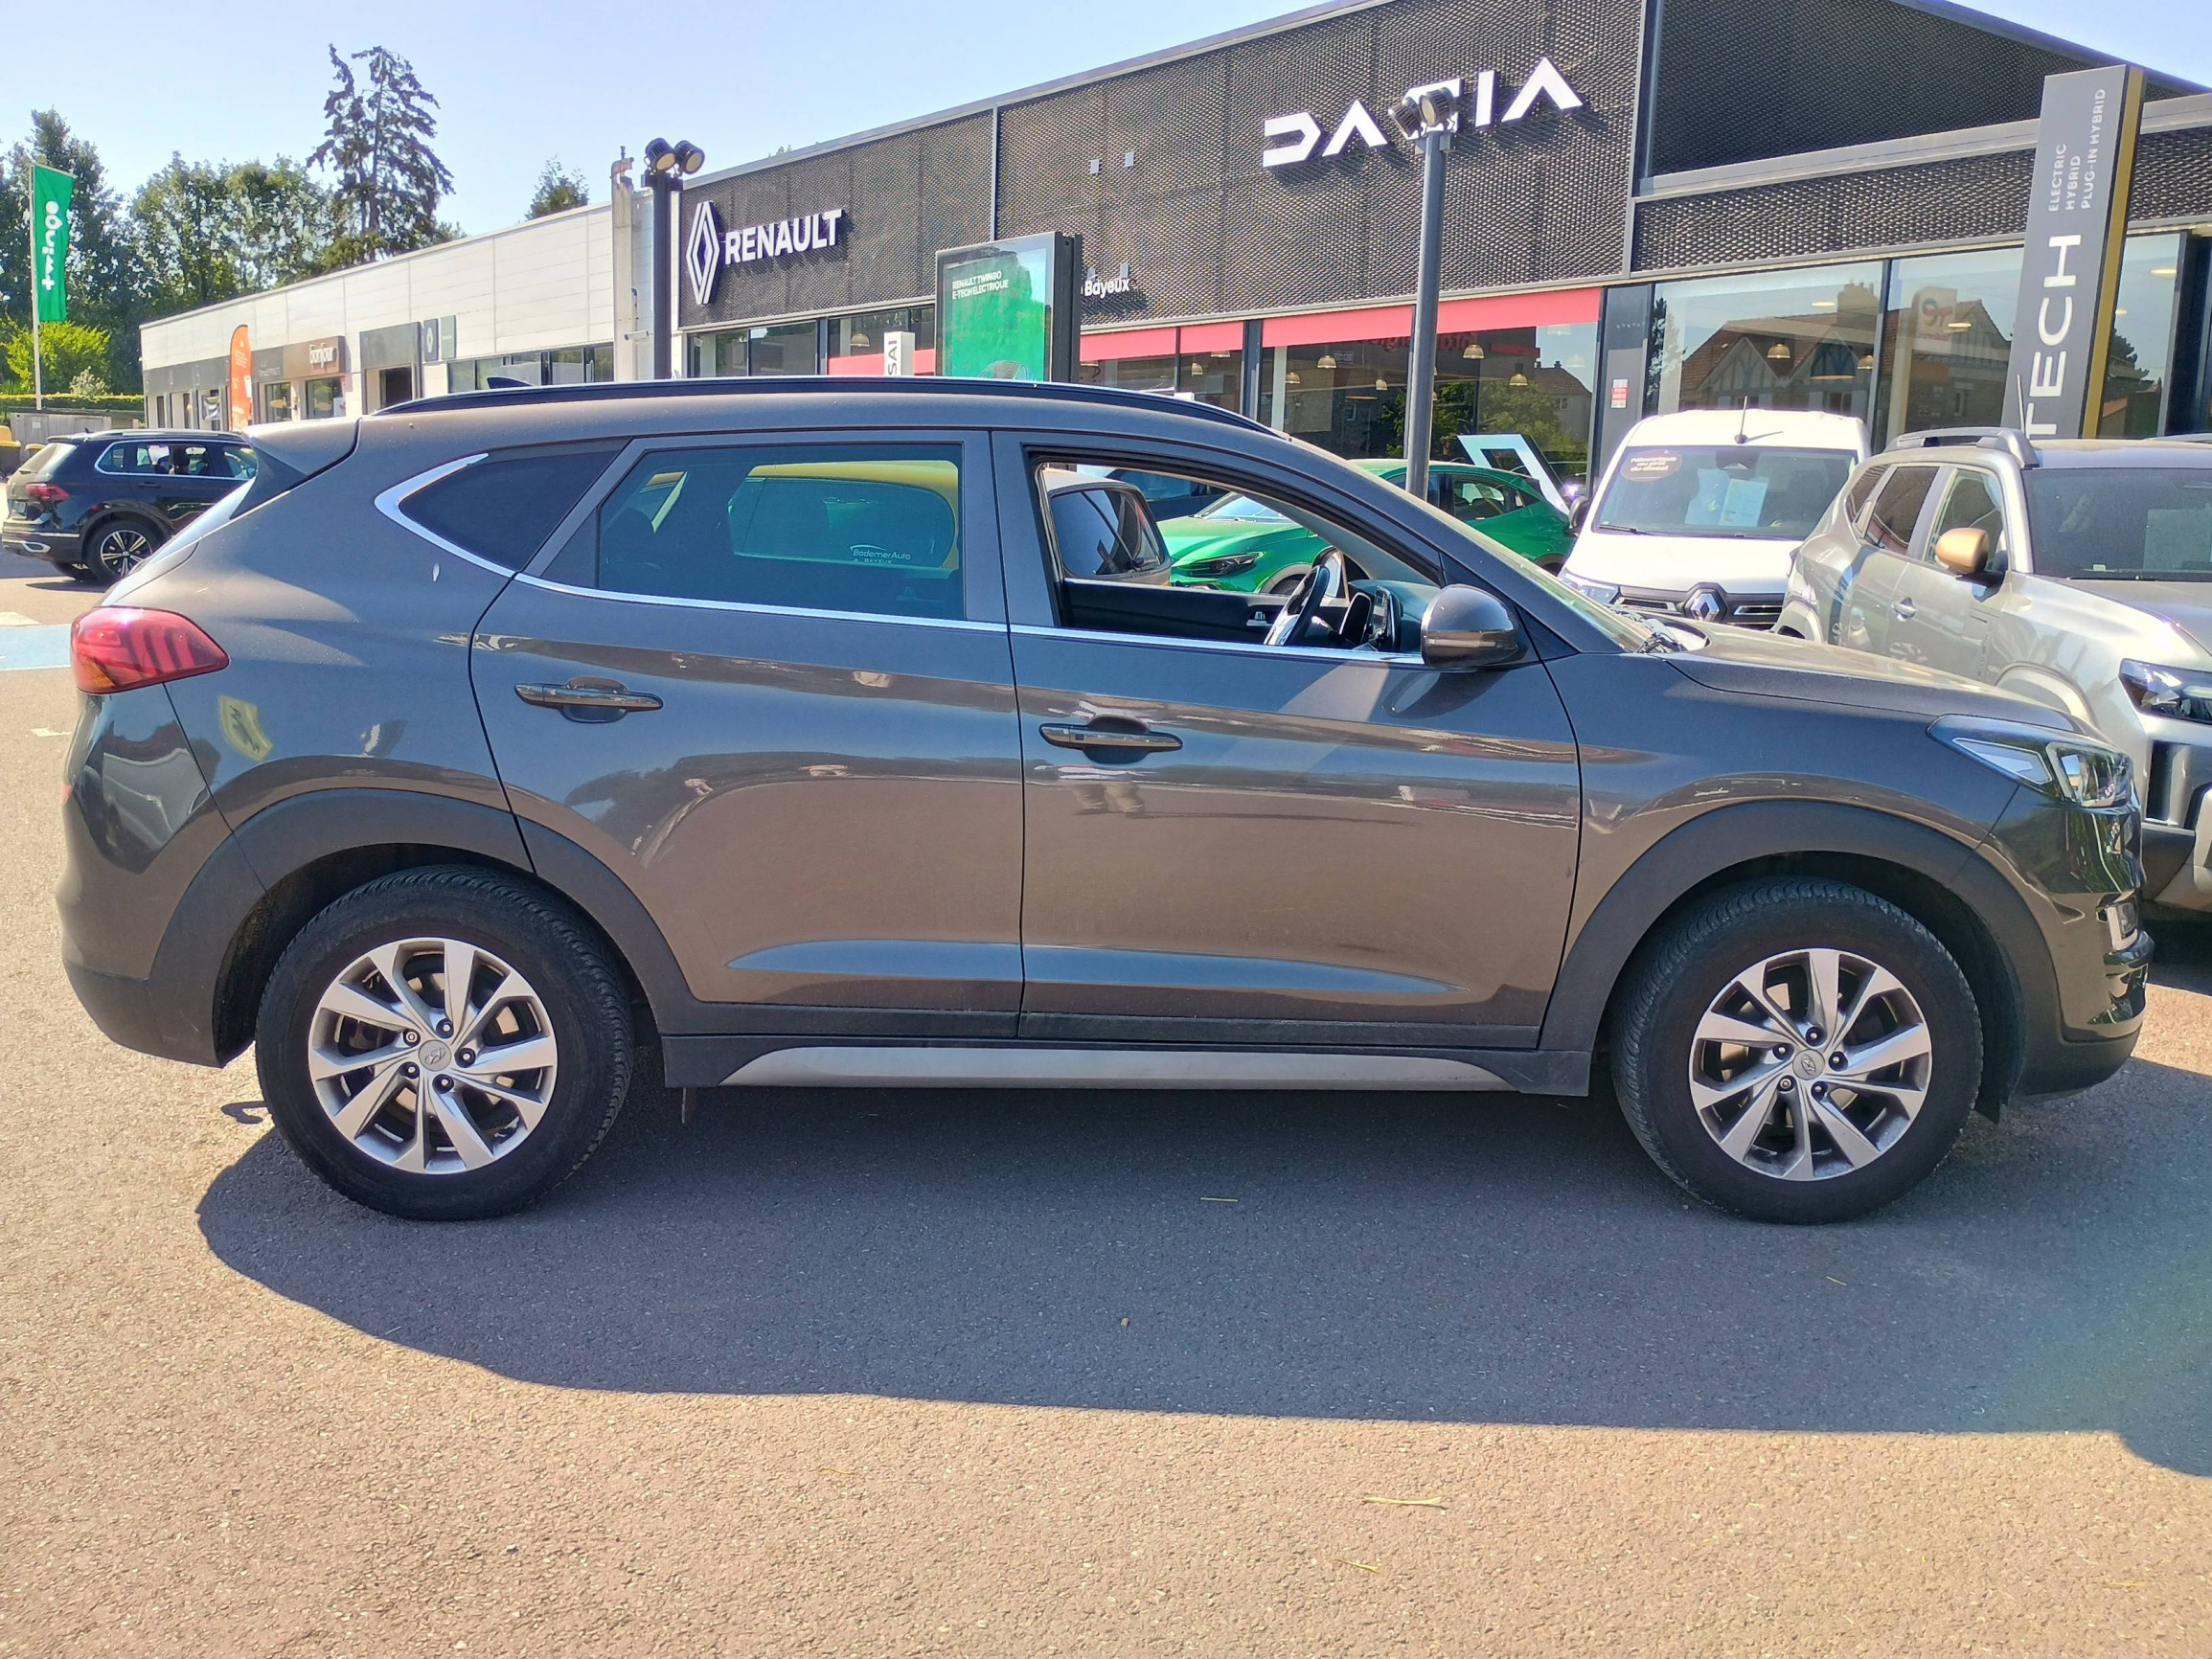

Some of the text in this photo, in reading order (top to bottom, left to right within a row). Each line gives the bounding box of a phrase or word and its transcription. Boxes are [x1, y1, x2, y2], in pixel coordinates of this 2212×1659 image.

[2081, 89, 2106, 209] PLUG-IN HYBRID
[2048, 144, 2066, 212] ELECTRIC
[2065, 155, 2081, 210] HYBRID
[725, 209, 842, 264] RENAULT
[952, 270, 1002, 290] RENAULT TWINGO
[952, 288, 973, 300] E-TECH
[1084, 278, 1130, 299] Bayeux
